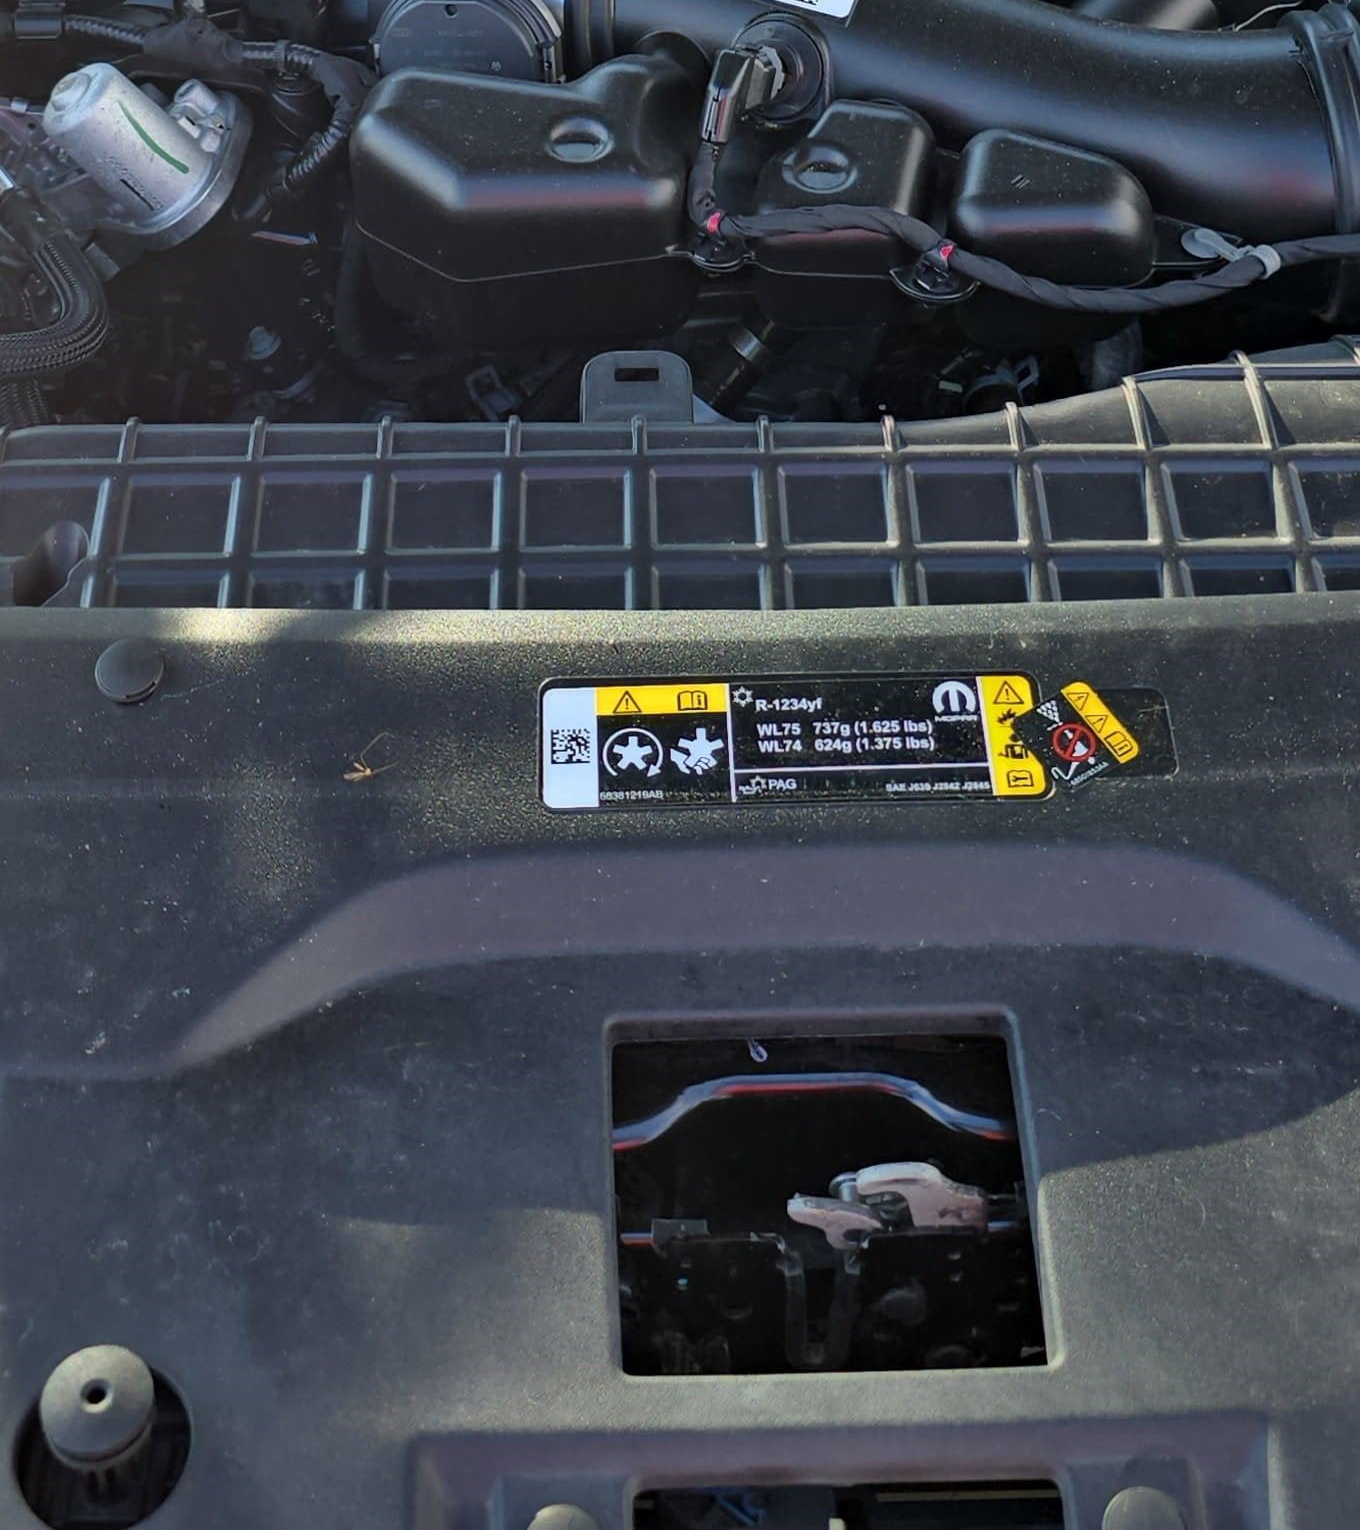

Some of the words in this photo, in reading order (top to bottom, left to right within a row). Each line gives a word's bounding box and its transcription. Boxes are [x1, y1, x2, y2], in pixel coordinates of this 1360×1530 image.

[754, 697, 823, 712] R-1234yf
[756, 723, 801, 738] WL75
[812, 722, 851, 737] 737g
[853, 720, 901, 736] (1.625
[903, 719, 934, 735] lbs)
[757, 740, 803, 754] WL74
[814, 739, 852, 754] 624g
[855, 737, 903, 753] (1.375
[905, 736, 936, 751] lbs)
[768, 778, 797, 790] PAG
